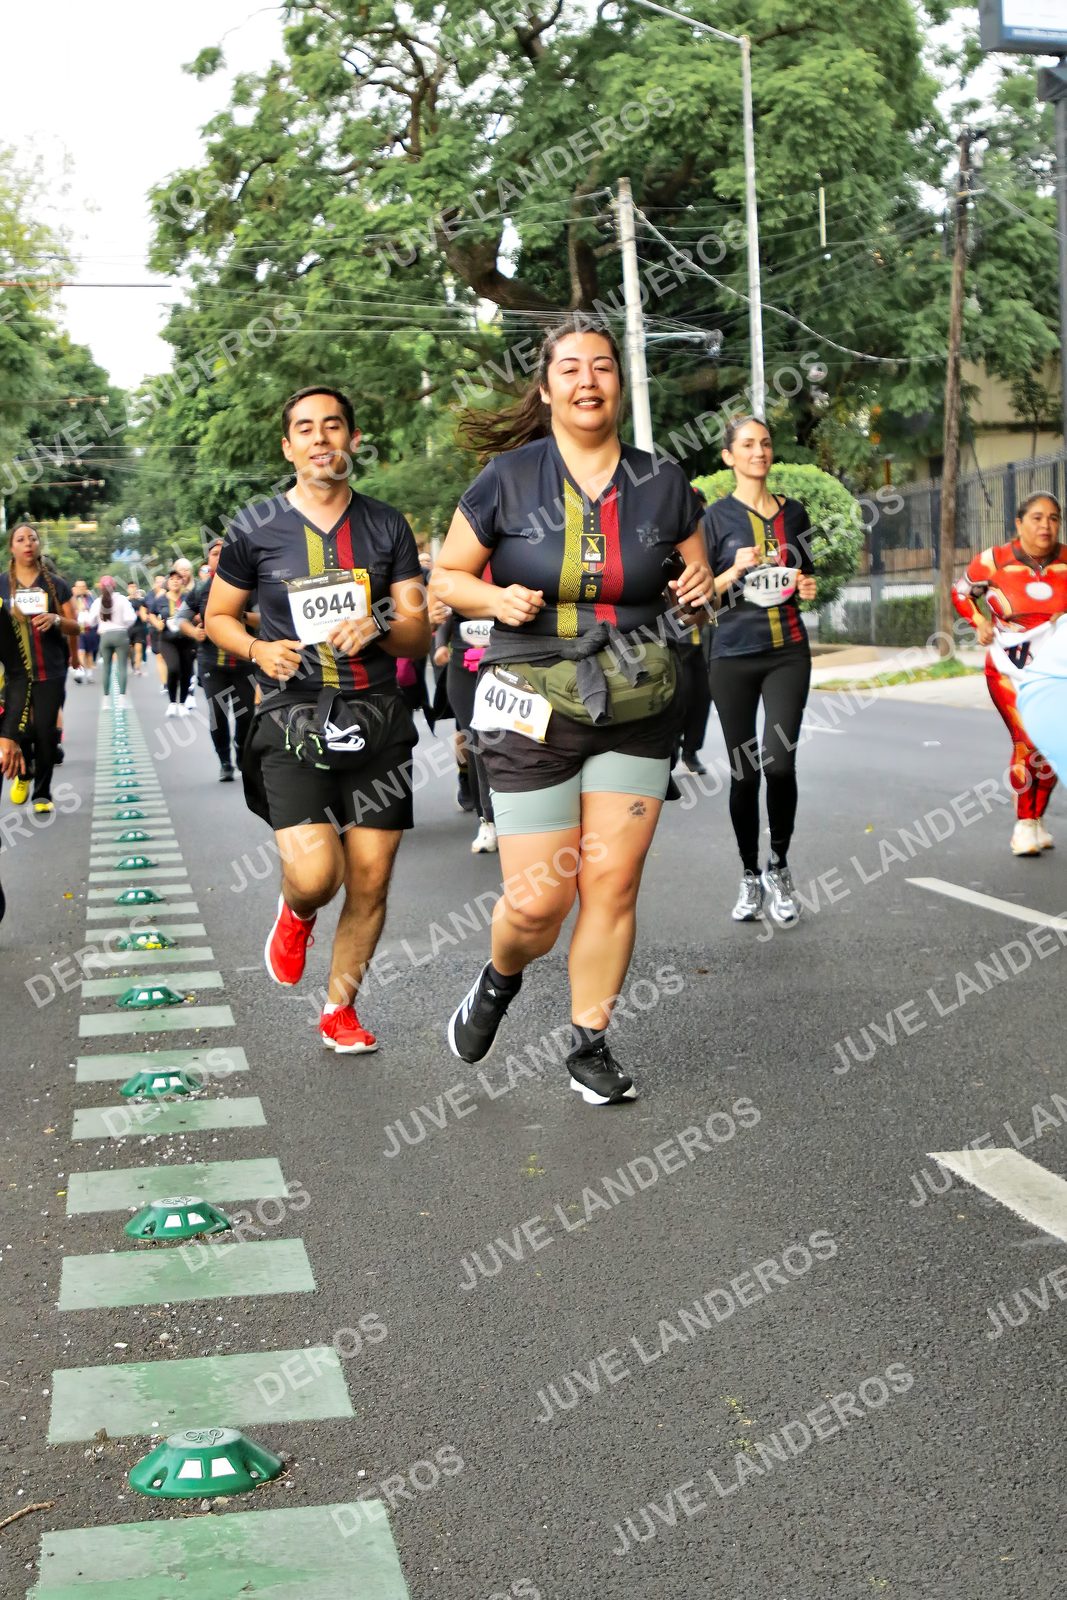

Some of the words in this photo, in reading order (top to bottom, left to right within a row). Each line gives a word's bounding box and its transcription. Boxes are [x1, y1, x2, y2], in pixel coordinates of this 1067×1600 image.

[751, 572, 790, 590] 4116
[302, 591, 356, 620] 6944
[466, 624, 490, 636] 648
[484, 685, 533, 719] 4070
